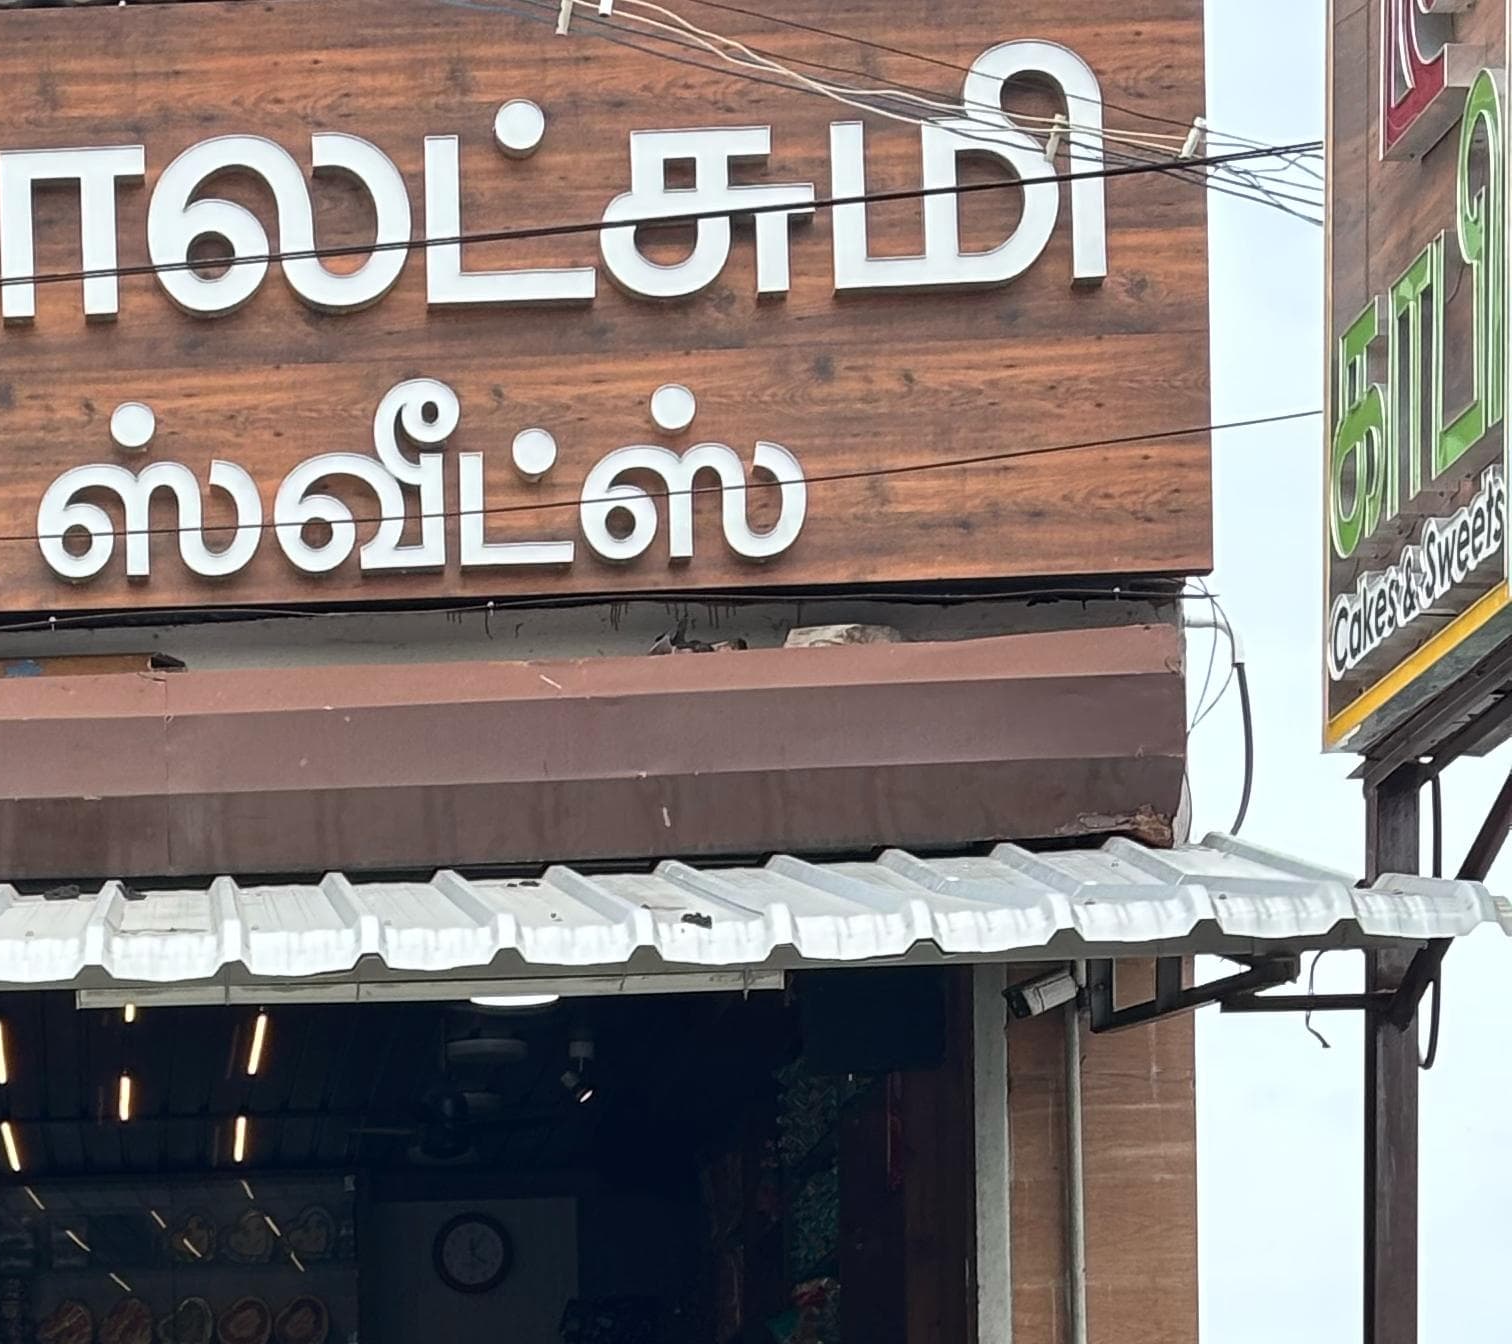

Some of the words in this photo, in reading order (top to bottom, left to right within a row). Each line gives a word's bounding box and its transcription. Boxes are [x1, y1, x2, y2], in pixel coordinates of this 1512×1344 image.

[36, 376, 808, 579] ஸ்வீட்ஸ்
[1333, 577, 1399, 674] Cakes
[1402, 551, 1418, 620] &
[1423, 478, 1505, 599] Sweets
